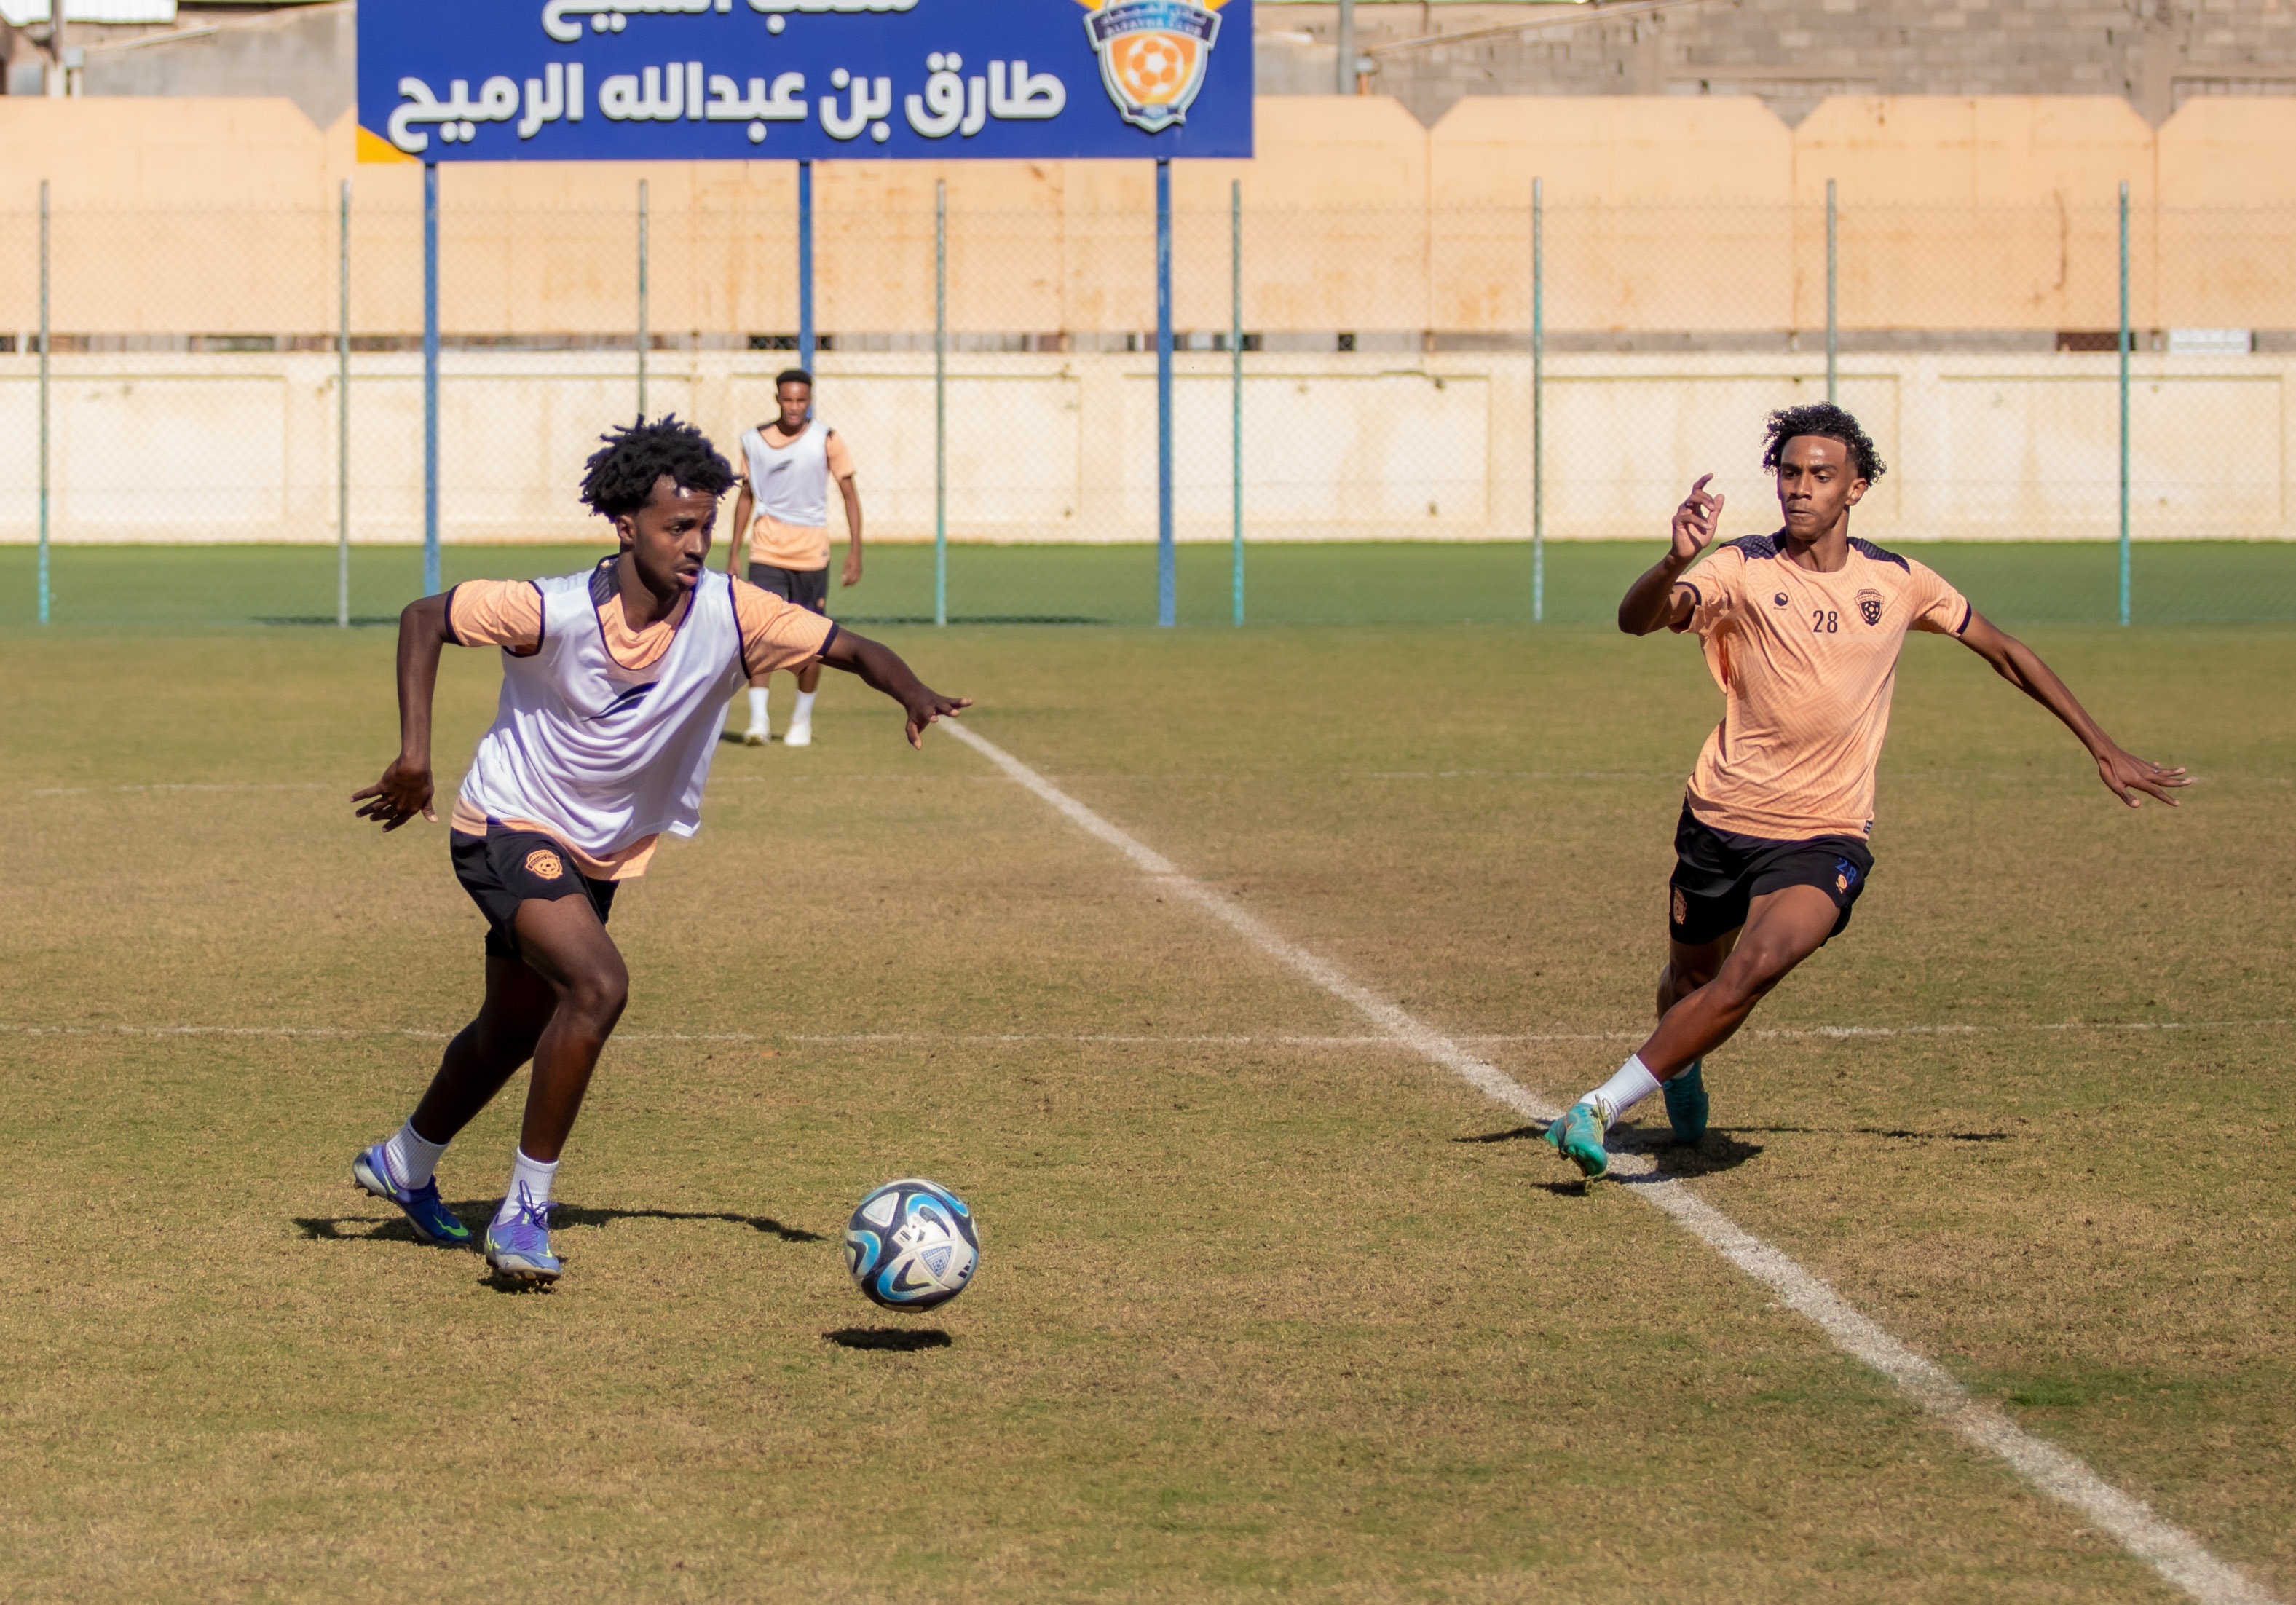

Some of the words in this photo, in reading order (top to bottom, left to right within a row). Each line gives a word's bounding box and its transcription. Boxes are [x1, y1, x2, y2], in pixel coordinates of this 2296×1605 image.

[387, 63, 583, 153] الرميح
[599, 62, 808, 143] عبدالله
[818, 68, 892, 142] بن
[904, 52, 1067, 138] طارق
[1812, 610, 1839, 634] 28
[1835, 857, 1856, 884] 28
